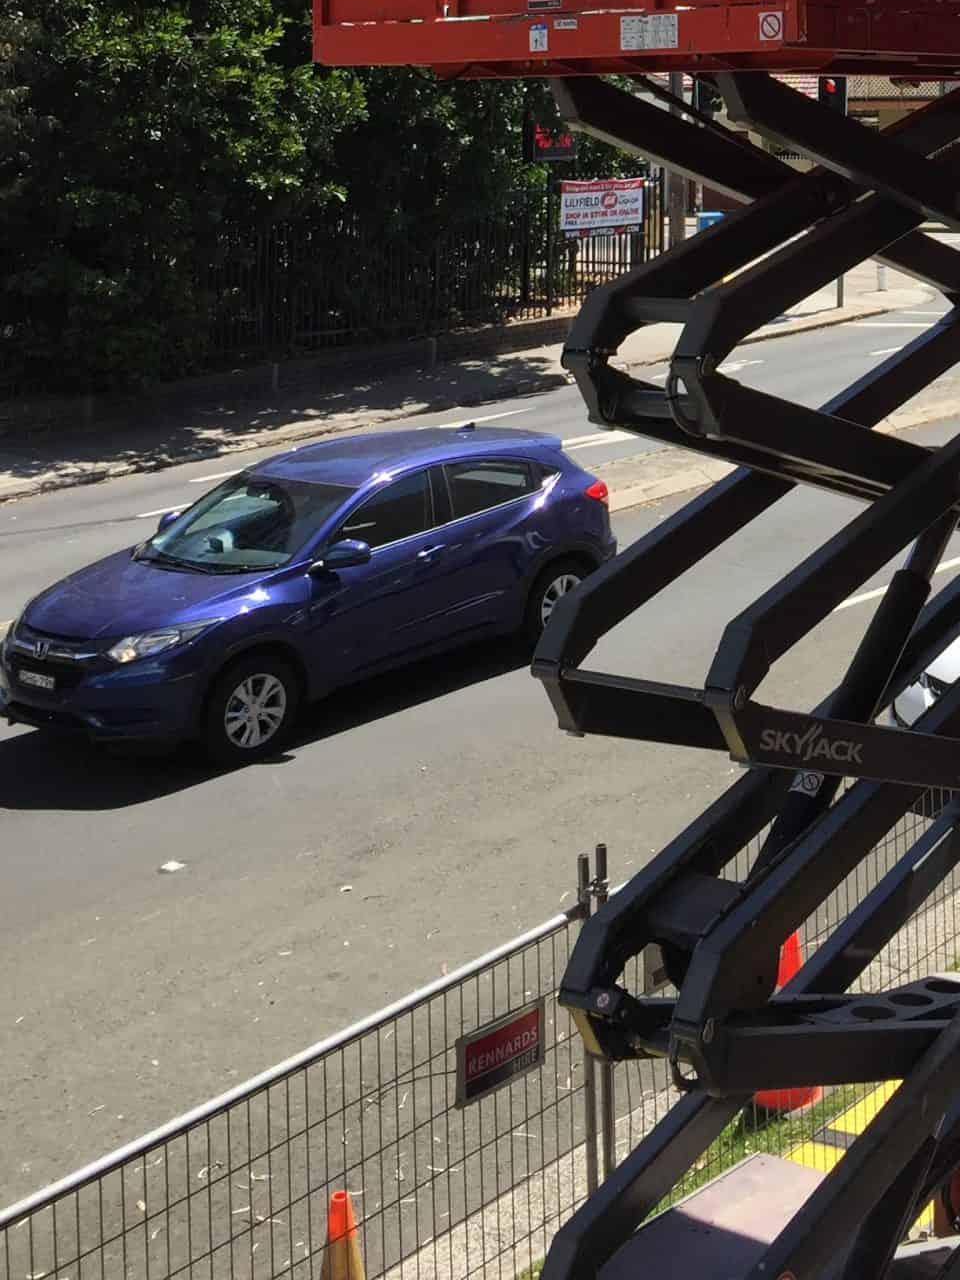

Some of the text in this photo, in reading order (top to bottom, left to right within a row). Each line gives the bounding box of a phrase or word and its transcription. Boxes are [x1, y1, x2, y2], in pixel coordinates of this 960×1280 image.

[564, 196, 600, 208] LILYFIELD
[565, 211, 582, 220] SHOP
[759, 721, 864, 764] SKYJACK
[468, 1026, 538, 1075] KENNARDS
